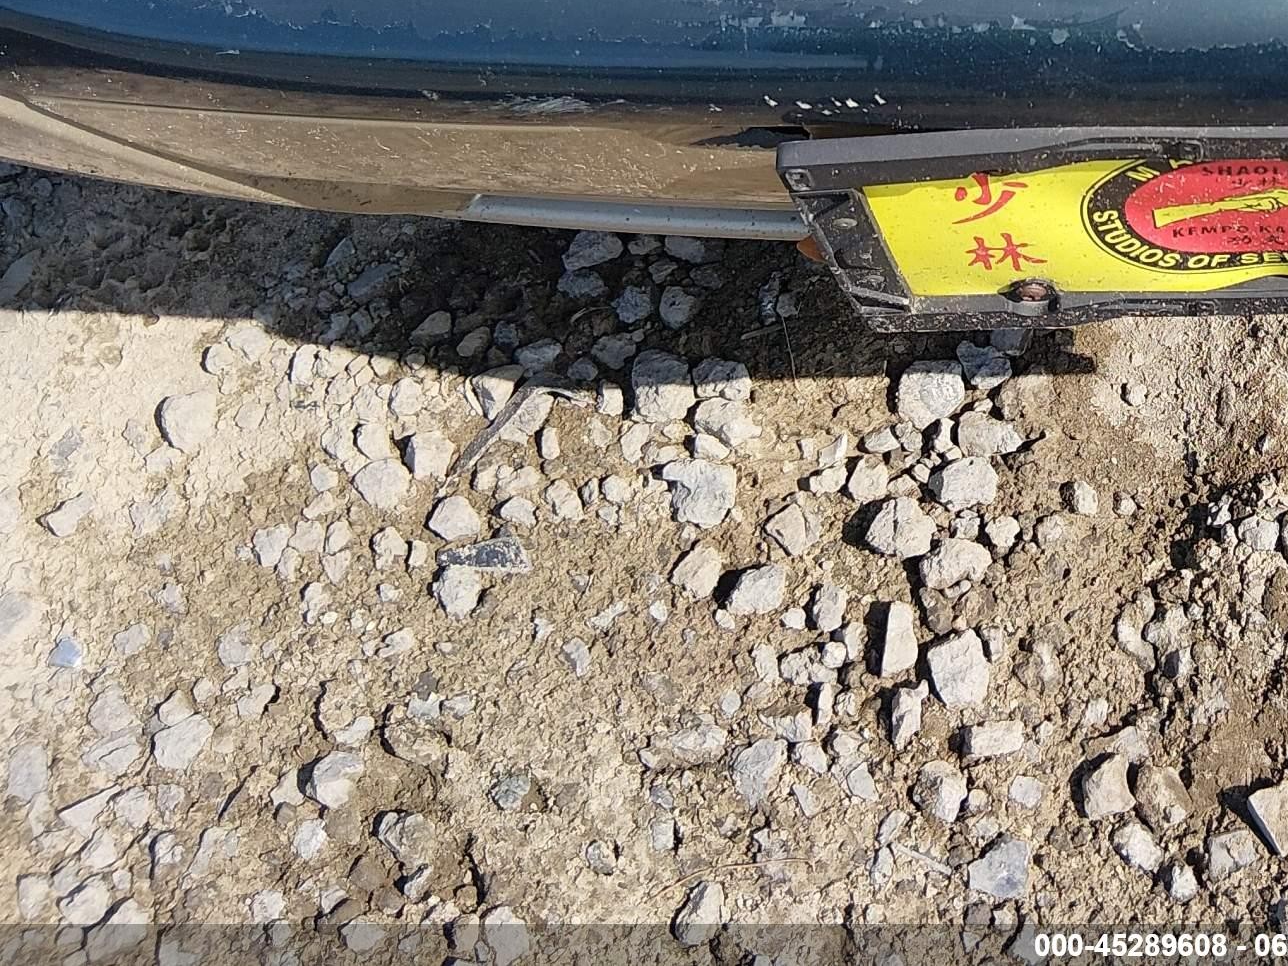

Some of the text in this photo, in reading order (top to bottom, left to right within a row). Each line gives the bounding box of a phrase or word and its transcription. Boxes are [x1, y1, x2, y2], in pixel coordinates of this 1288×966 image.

[951, 171, 1048, 272] 少林
[1093, 210, 1182, 268] STUDIOS
[1187, 254, 1231, 269] OF
[1172, 225, 1249, 238] KEMPO
